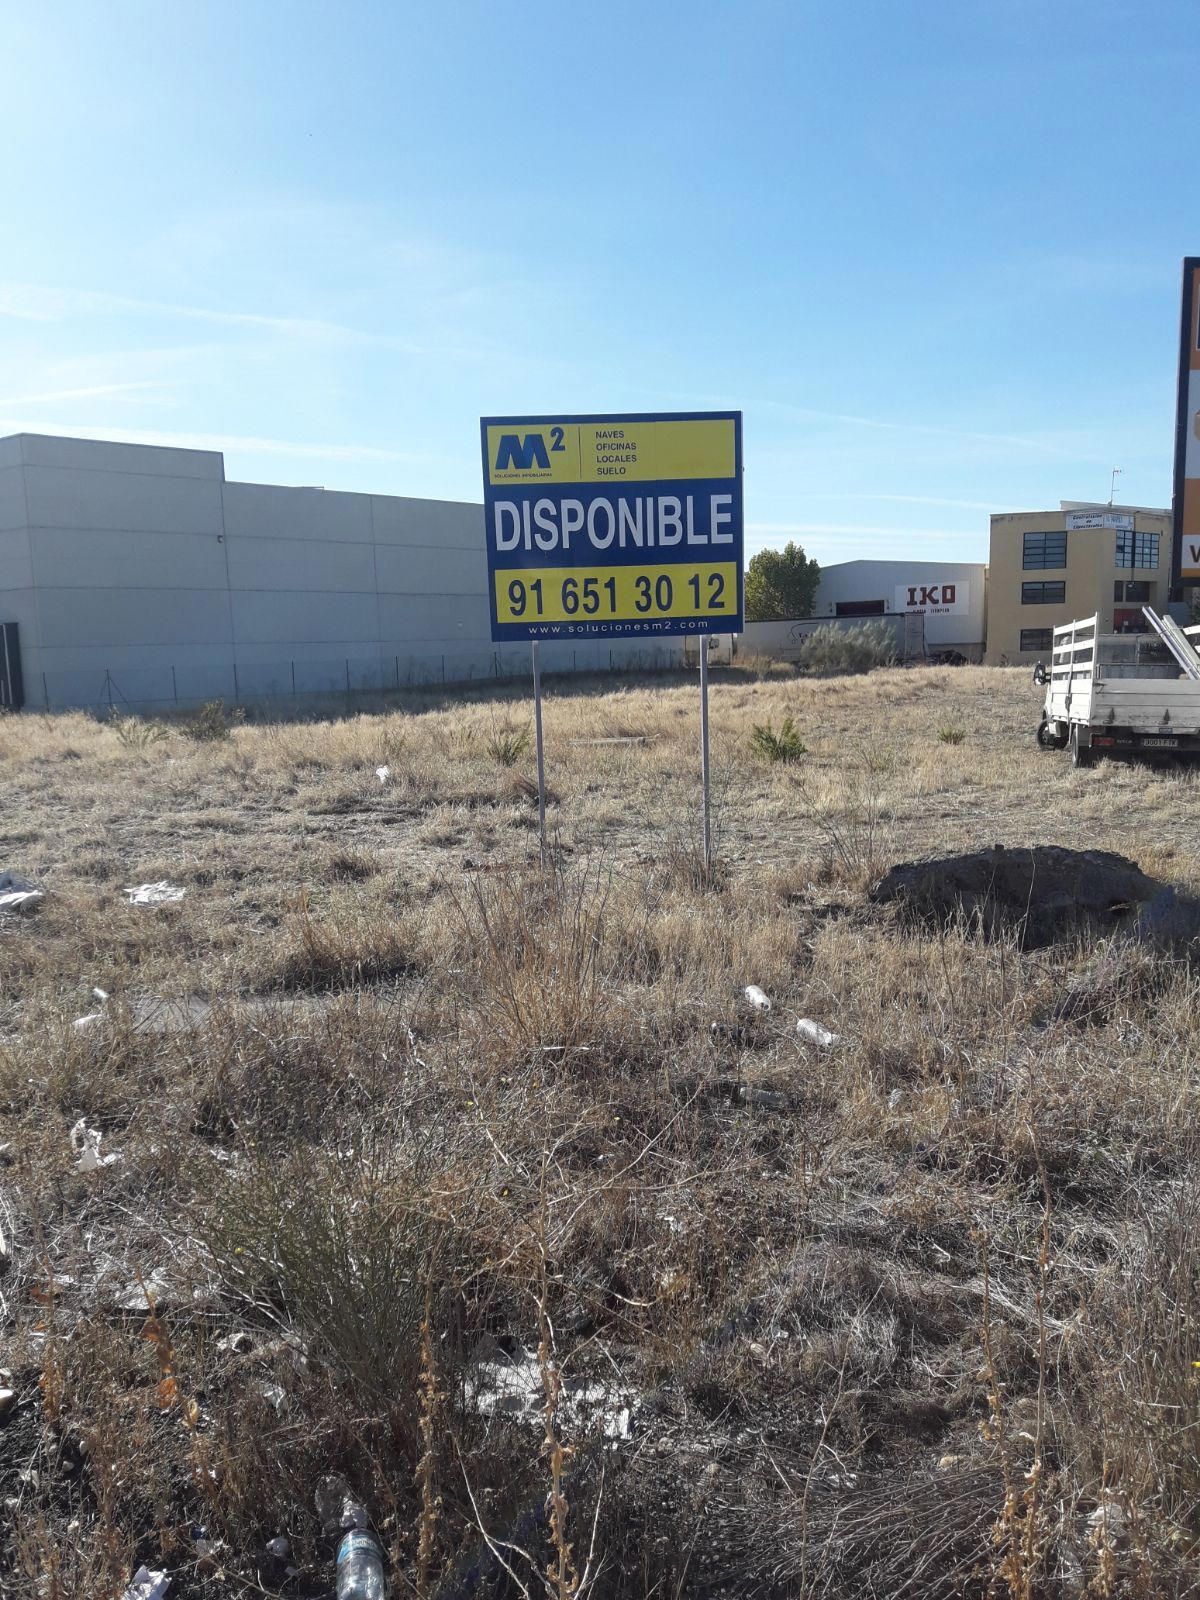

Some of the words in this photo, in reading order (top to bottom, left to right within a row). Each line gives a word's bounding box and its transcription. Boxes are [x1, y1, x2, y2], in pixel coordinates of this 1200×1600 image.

[595, 430, 624, 439] NAVES
[595, 442, 637, 451] OFICINAS
[596, 454, 637, 463] LOCALES
[596, 467, 626, 476] SUELO
[494, 494, 734, 551] DISPONIBLE
[508, 578, 544, 616] 91
[561, 576, 616, 615] 651
[634, 574, 673, 613] 30
[687, 572, 725, 610] 12
[906, 585, 956, 606] IKO
[528, 620, 709, 635] www.solucionesm2.com
